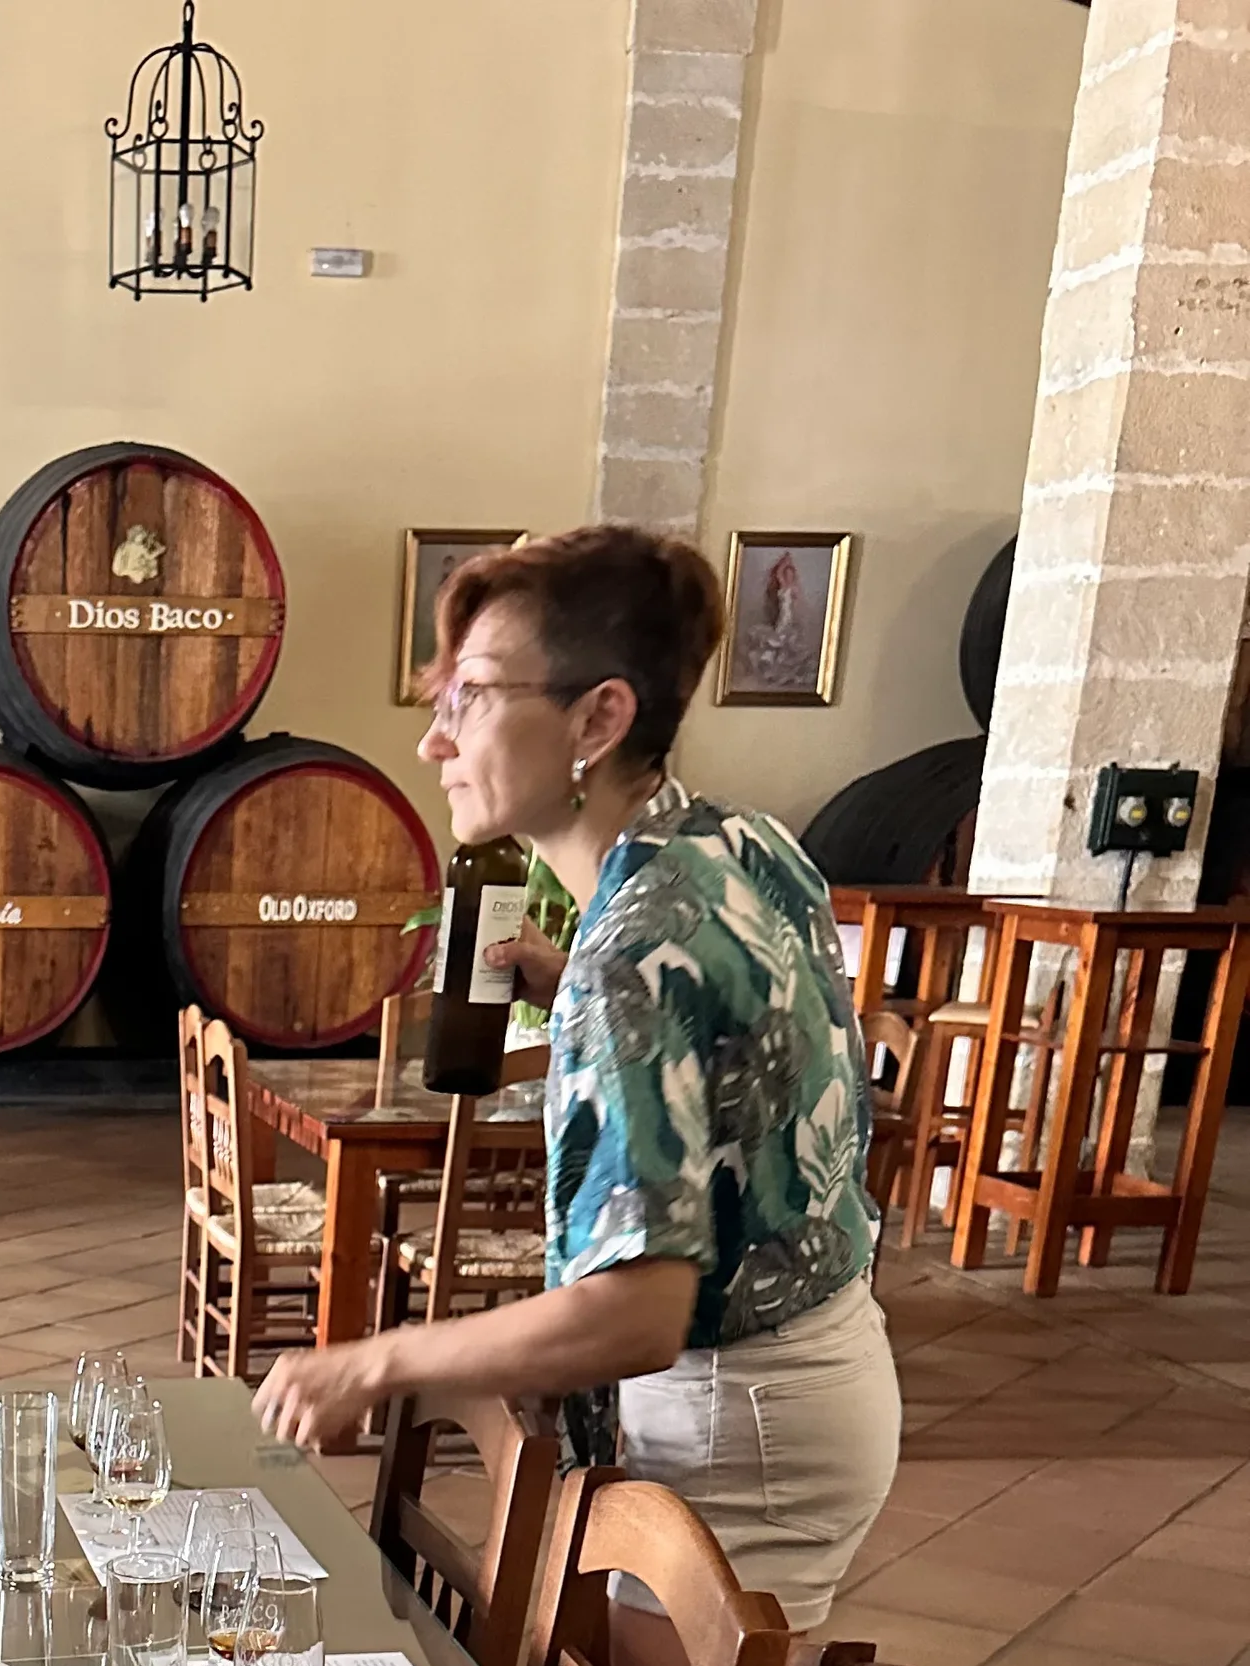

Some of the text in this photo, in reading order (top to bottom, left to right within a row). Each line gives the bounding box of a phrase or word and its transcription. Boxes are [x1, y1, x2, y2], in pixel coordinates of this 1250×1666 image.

[68, 600, 224, 632] Dios Baco
[258, 895, 358, 921] OLD OXFORD
